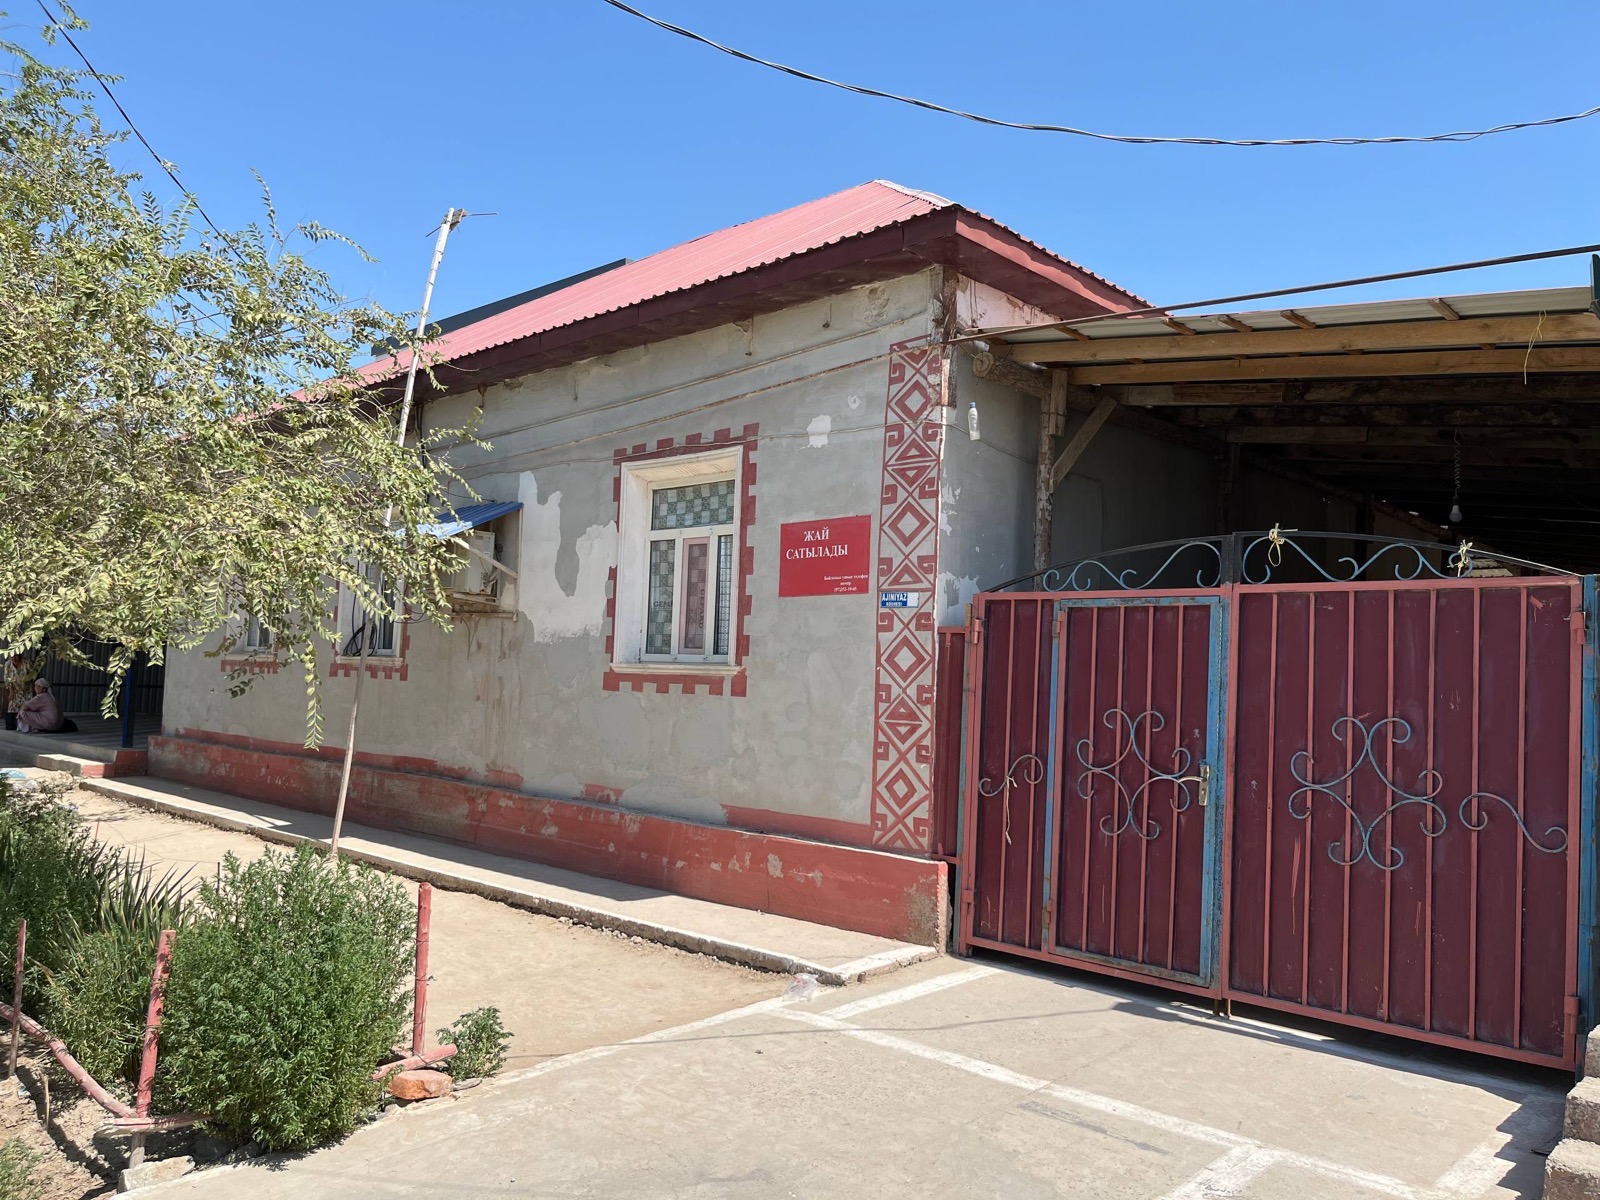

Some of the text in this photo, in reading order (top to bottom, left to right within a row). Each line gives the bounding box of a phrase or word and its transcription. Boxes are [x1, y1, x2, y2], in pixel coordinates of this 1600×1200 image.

[804, 526, 829, 541] ЖАЙ
[786, 544, 848, 560] САТЫЛАДЫ
[882, 592, 907, 601] AJINIYAZ
